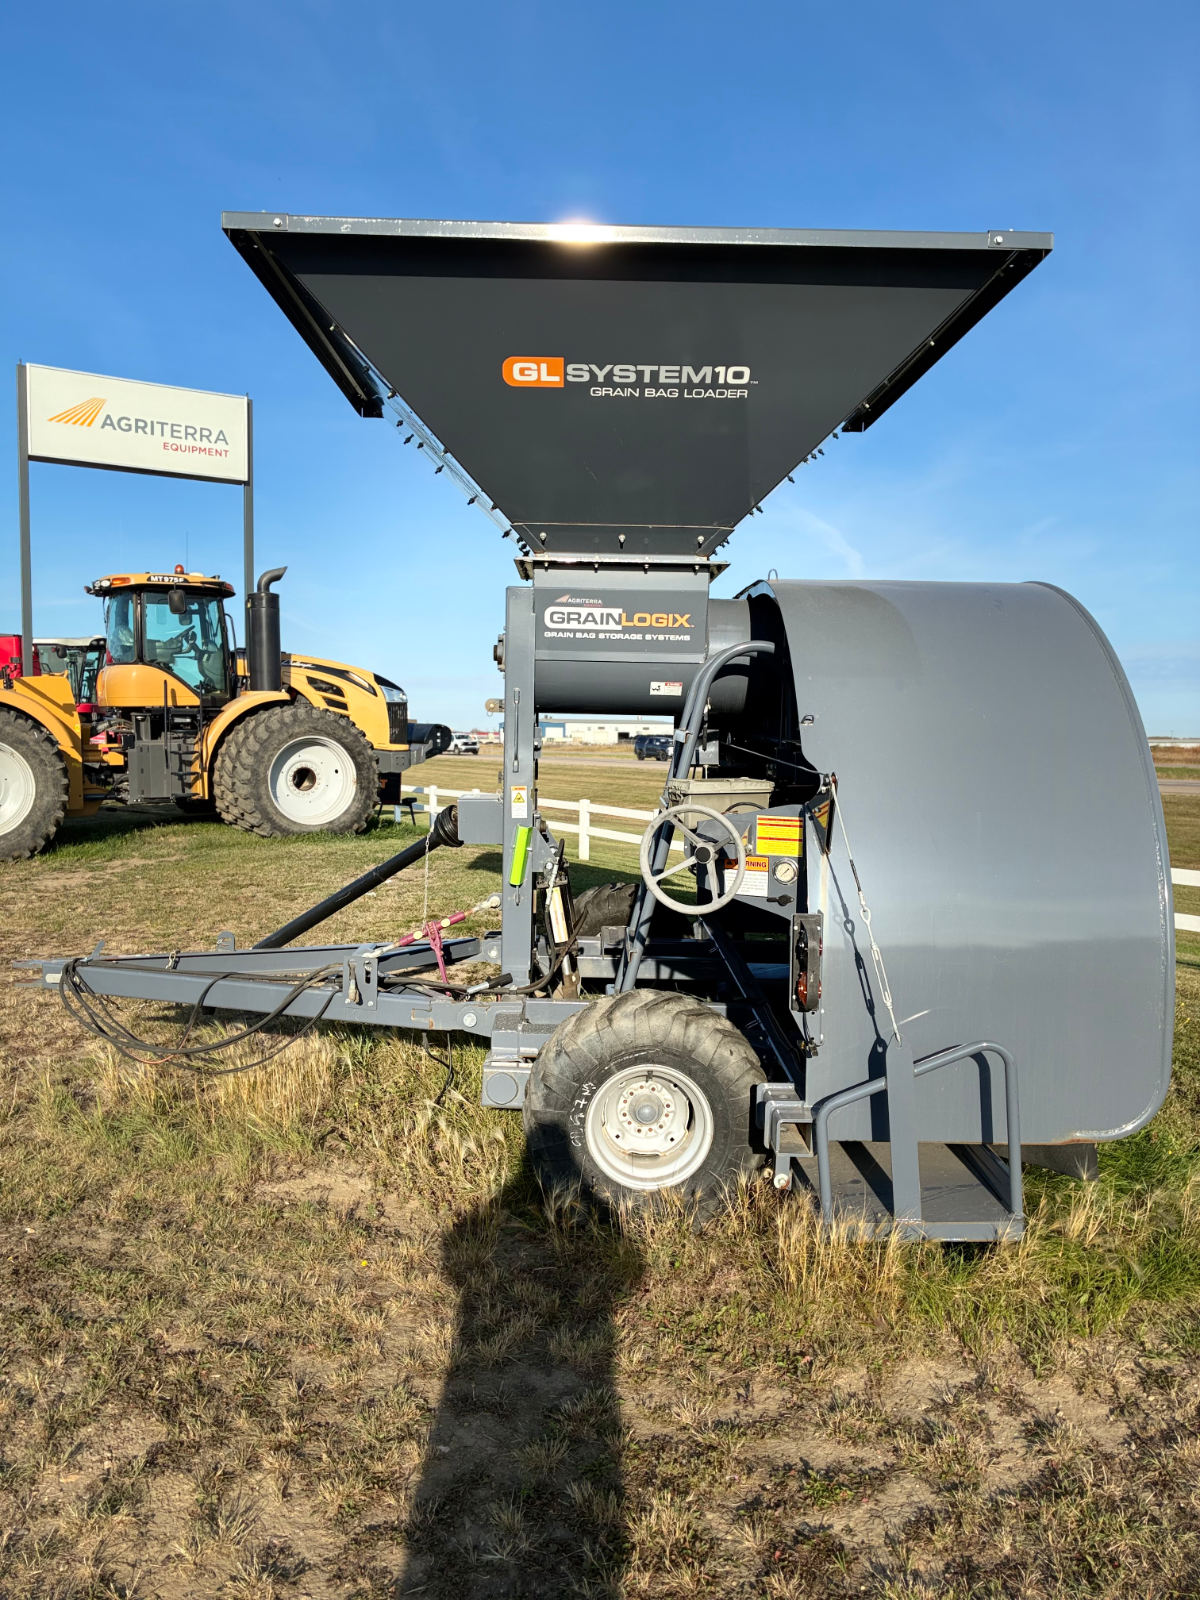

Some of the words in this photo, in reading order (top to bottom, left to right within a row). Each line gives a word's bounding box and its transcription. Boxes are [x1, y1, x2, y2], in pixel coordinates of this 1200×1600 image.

[590, 387, 640, 398] GRAIN
[644, 388, 679, 398] BAG
[683, 388, 749, 399] LOADER
[101, 413, 229, 446] AGRITERRA
[163, 442, 230, 458] EQUIPMENT
